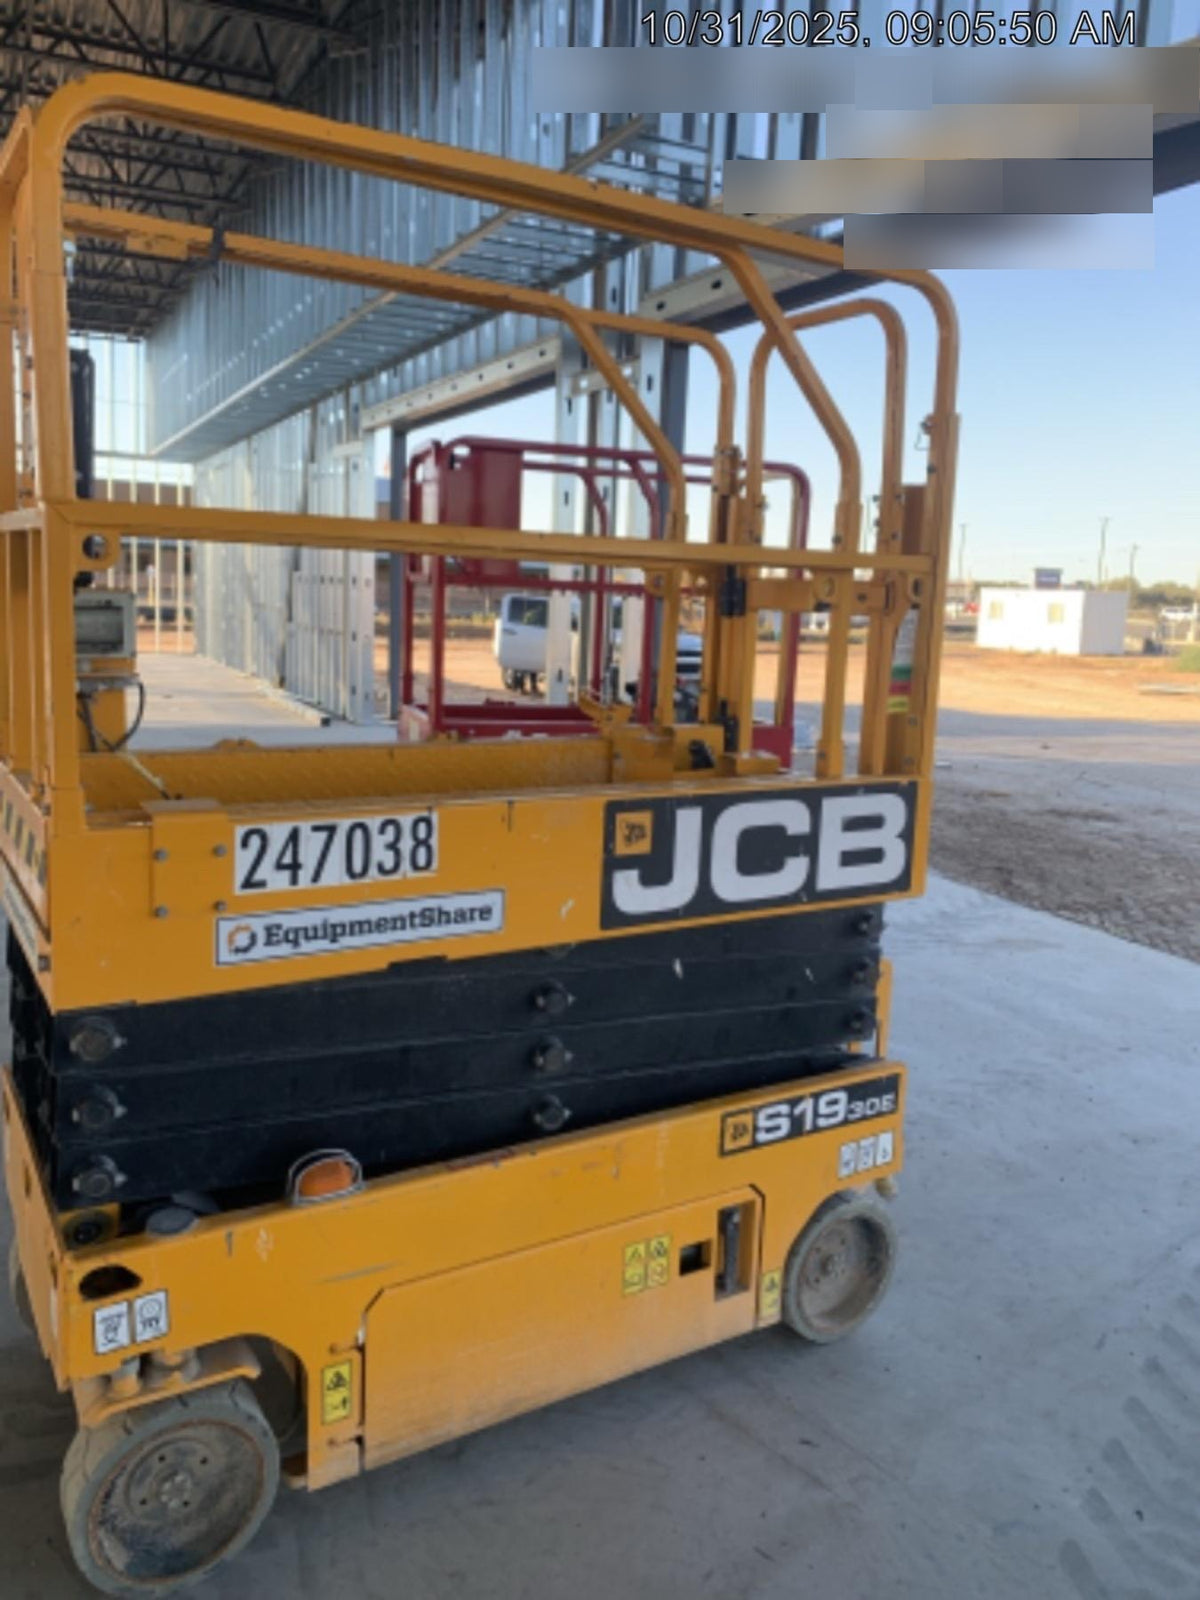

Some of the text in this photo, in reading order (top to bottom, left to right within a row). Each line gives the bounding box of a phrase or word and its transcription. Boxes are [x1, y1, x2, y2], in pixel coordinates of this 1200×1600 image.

[240, 815, 434, 891] 247038
[612, 793, 907, 915] JCB
[262, 904, 493, 949] EquipmentShare
